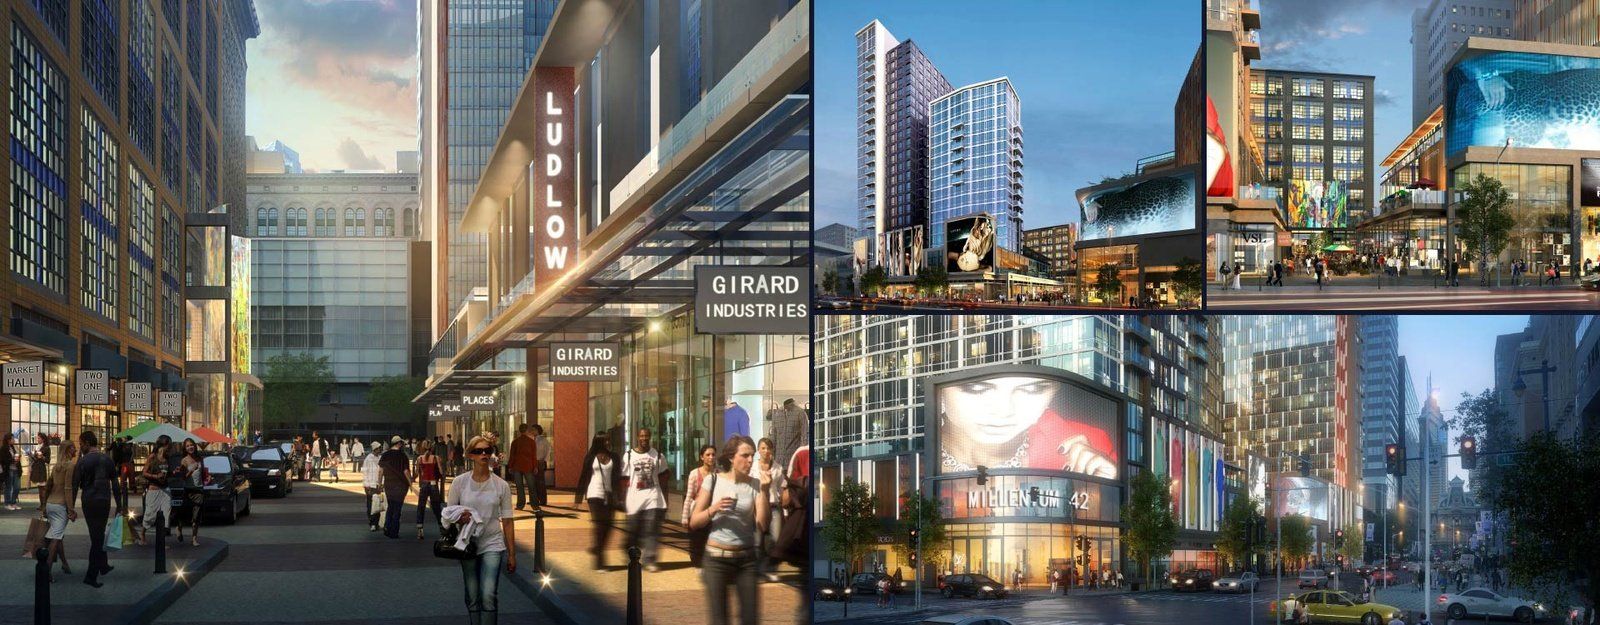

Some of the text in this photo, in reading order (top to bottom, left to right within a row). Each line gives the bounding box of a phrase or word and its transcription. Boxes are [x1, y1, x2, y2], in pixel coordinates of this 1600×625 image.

[544, 91, 568, 270] LUDLOW
[712, 274, 799, 294] GIRARD
[706, 303, 807, 318] INDUSTRIES
[556, 347, 612, 361] GIRARD
[6, 366, 40, 374] MARKET
[552, 366, 617, 376] INDUSTRIES
[7, 378, 38, 388] HALL
[83, 383, 102, 391] ONE
[463, 396, 494, 405] PLACES
[1069, 490, 1089, 510] 42
